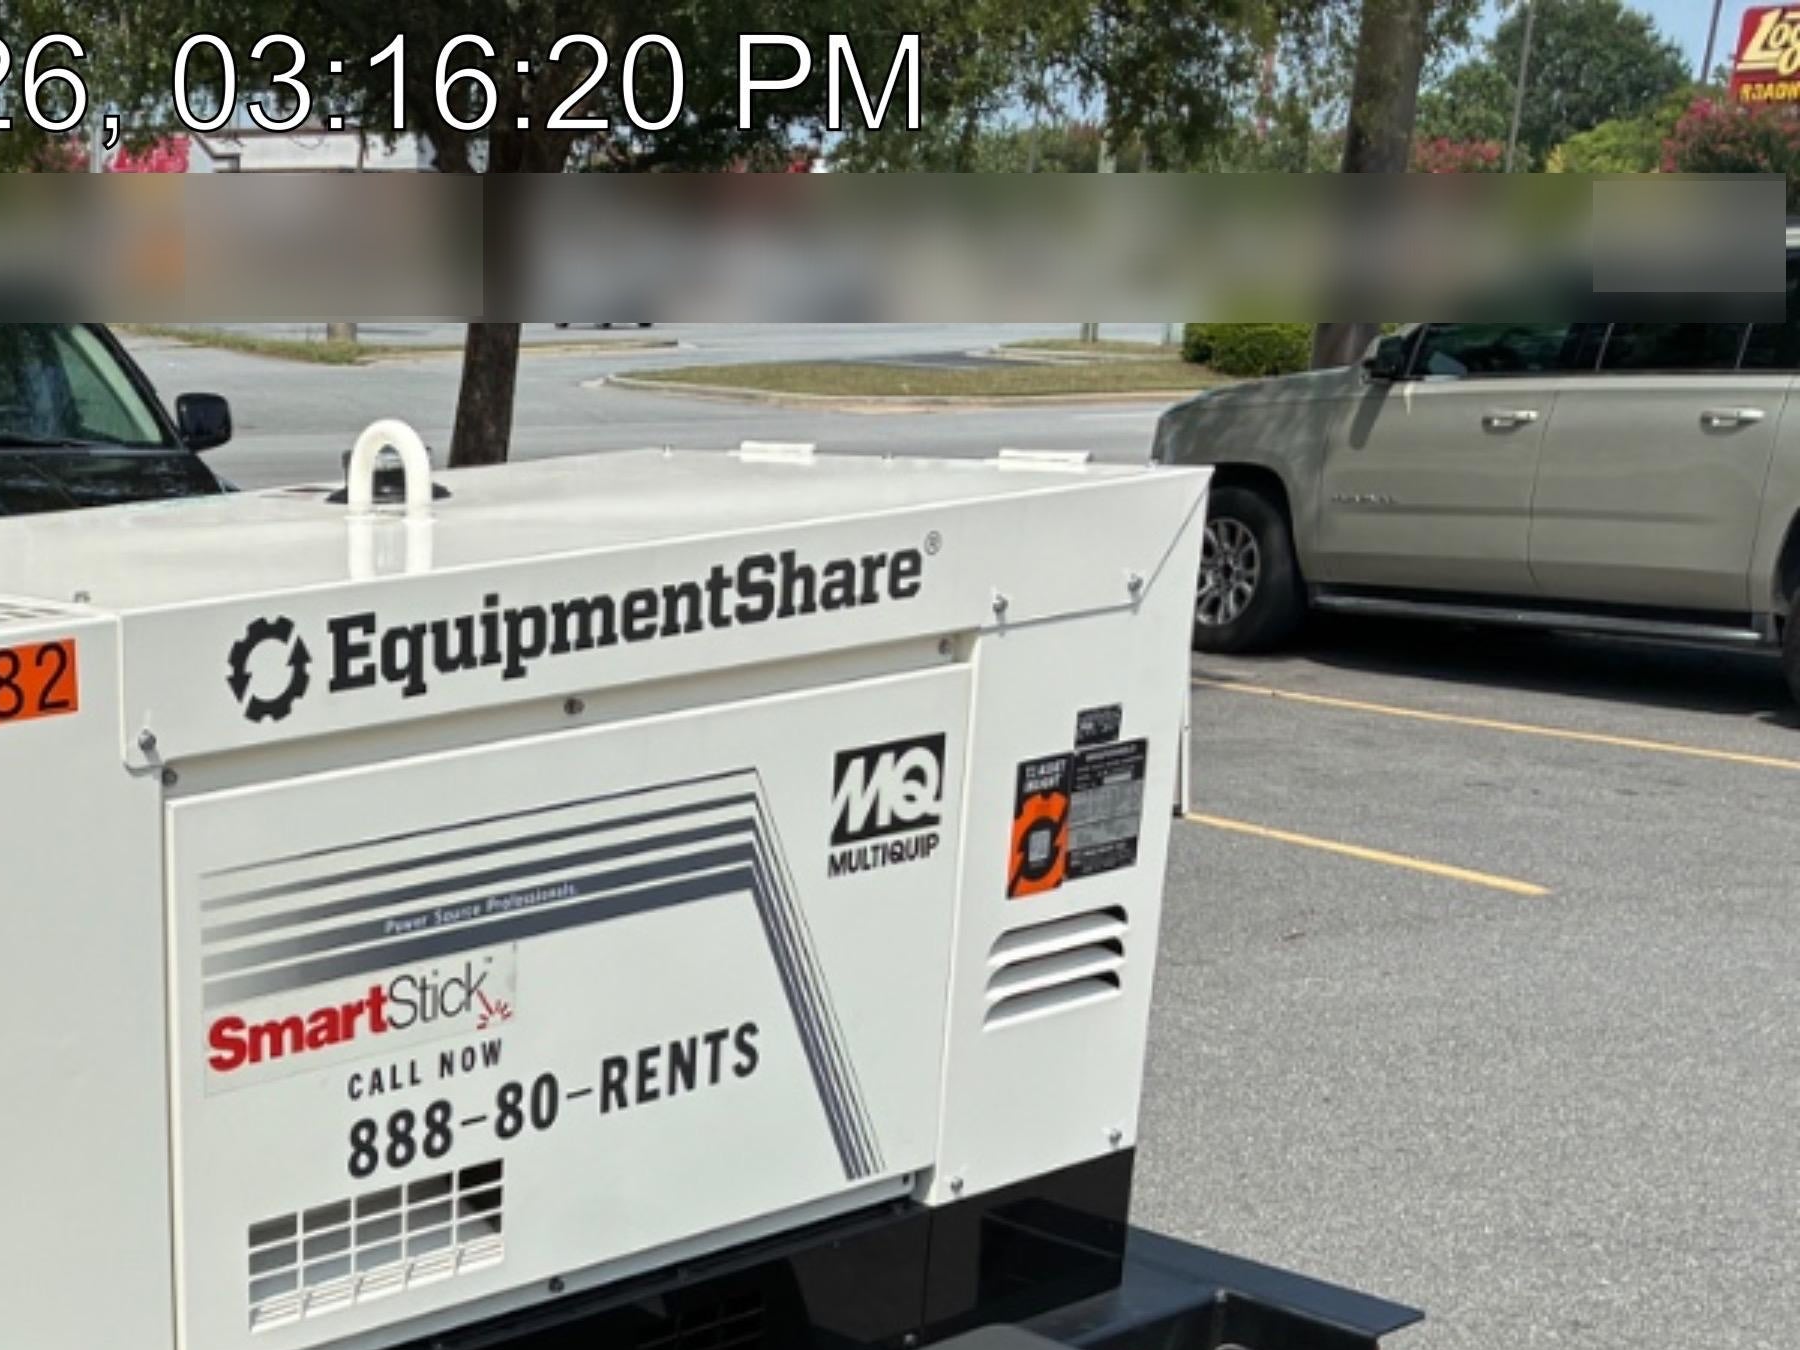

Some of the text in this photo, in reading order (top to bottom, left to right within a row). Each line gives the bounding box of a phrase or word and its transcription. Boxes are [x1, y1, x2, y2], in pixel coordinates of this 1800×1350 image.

[831, 746, 942, 834] MQ
[827, 832, 940, 880] MULTIQUIP
[384, 914, 427, 934] Power
[435, 903, 481, 925] Source
[348, 1038, 502, 1101] CALL NOW
[348, 1021, 760, 1179] 888-80-RENTS
